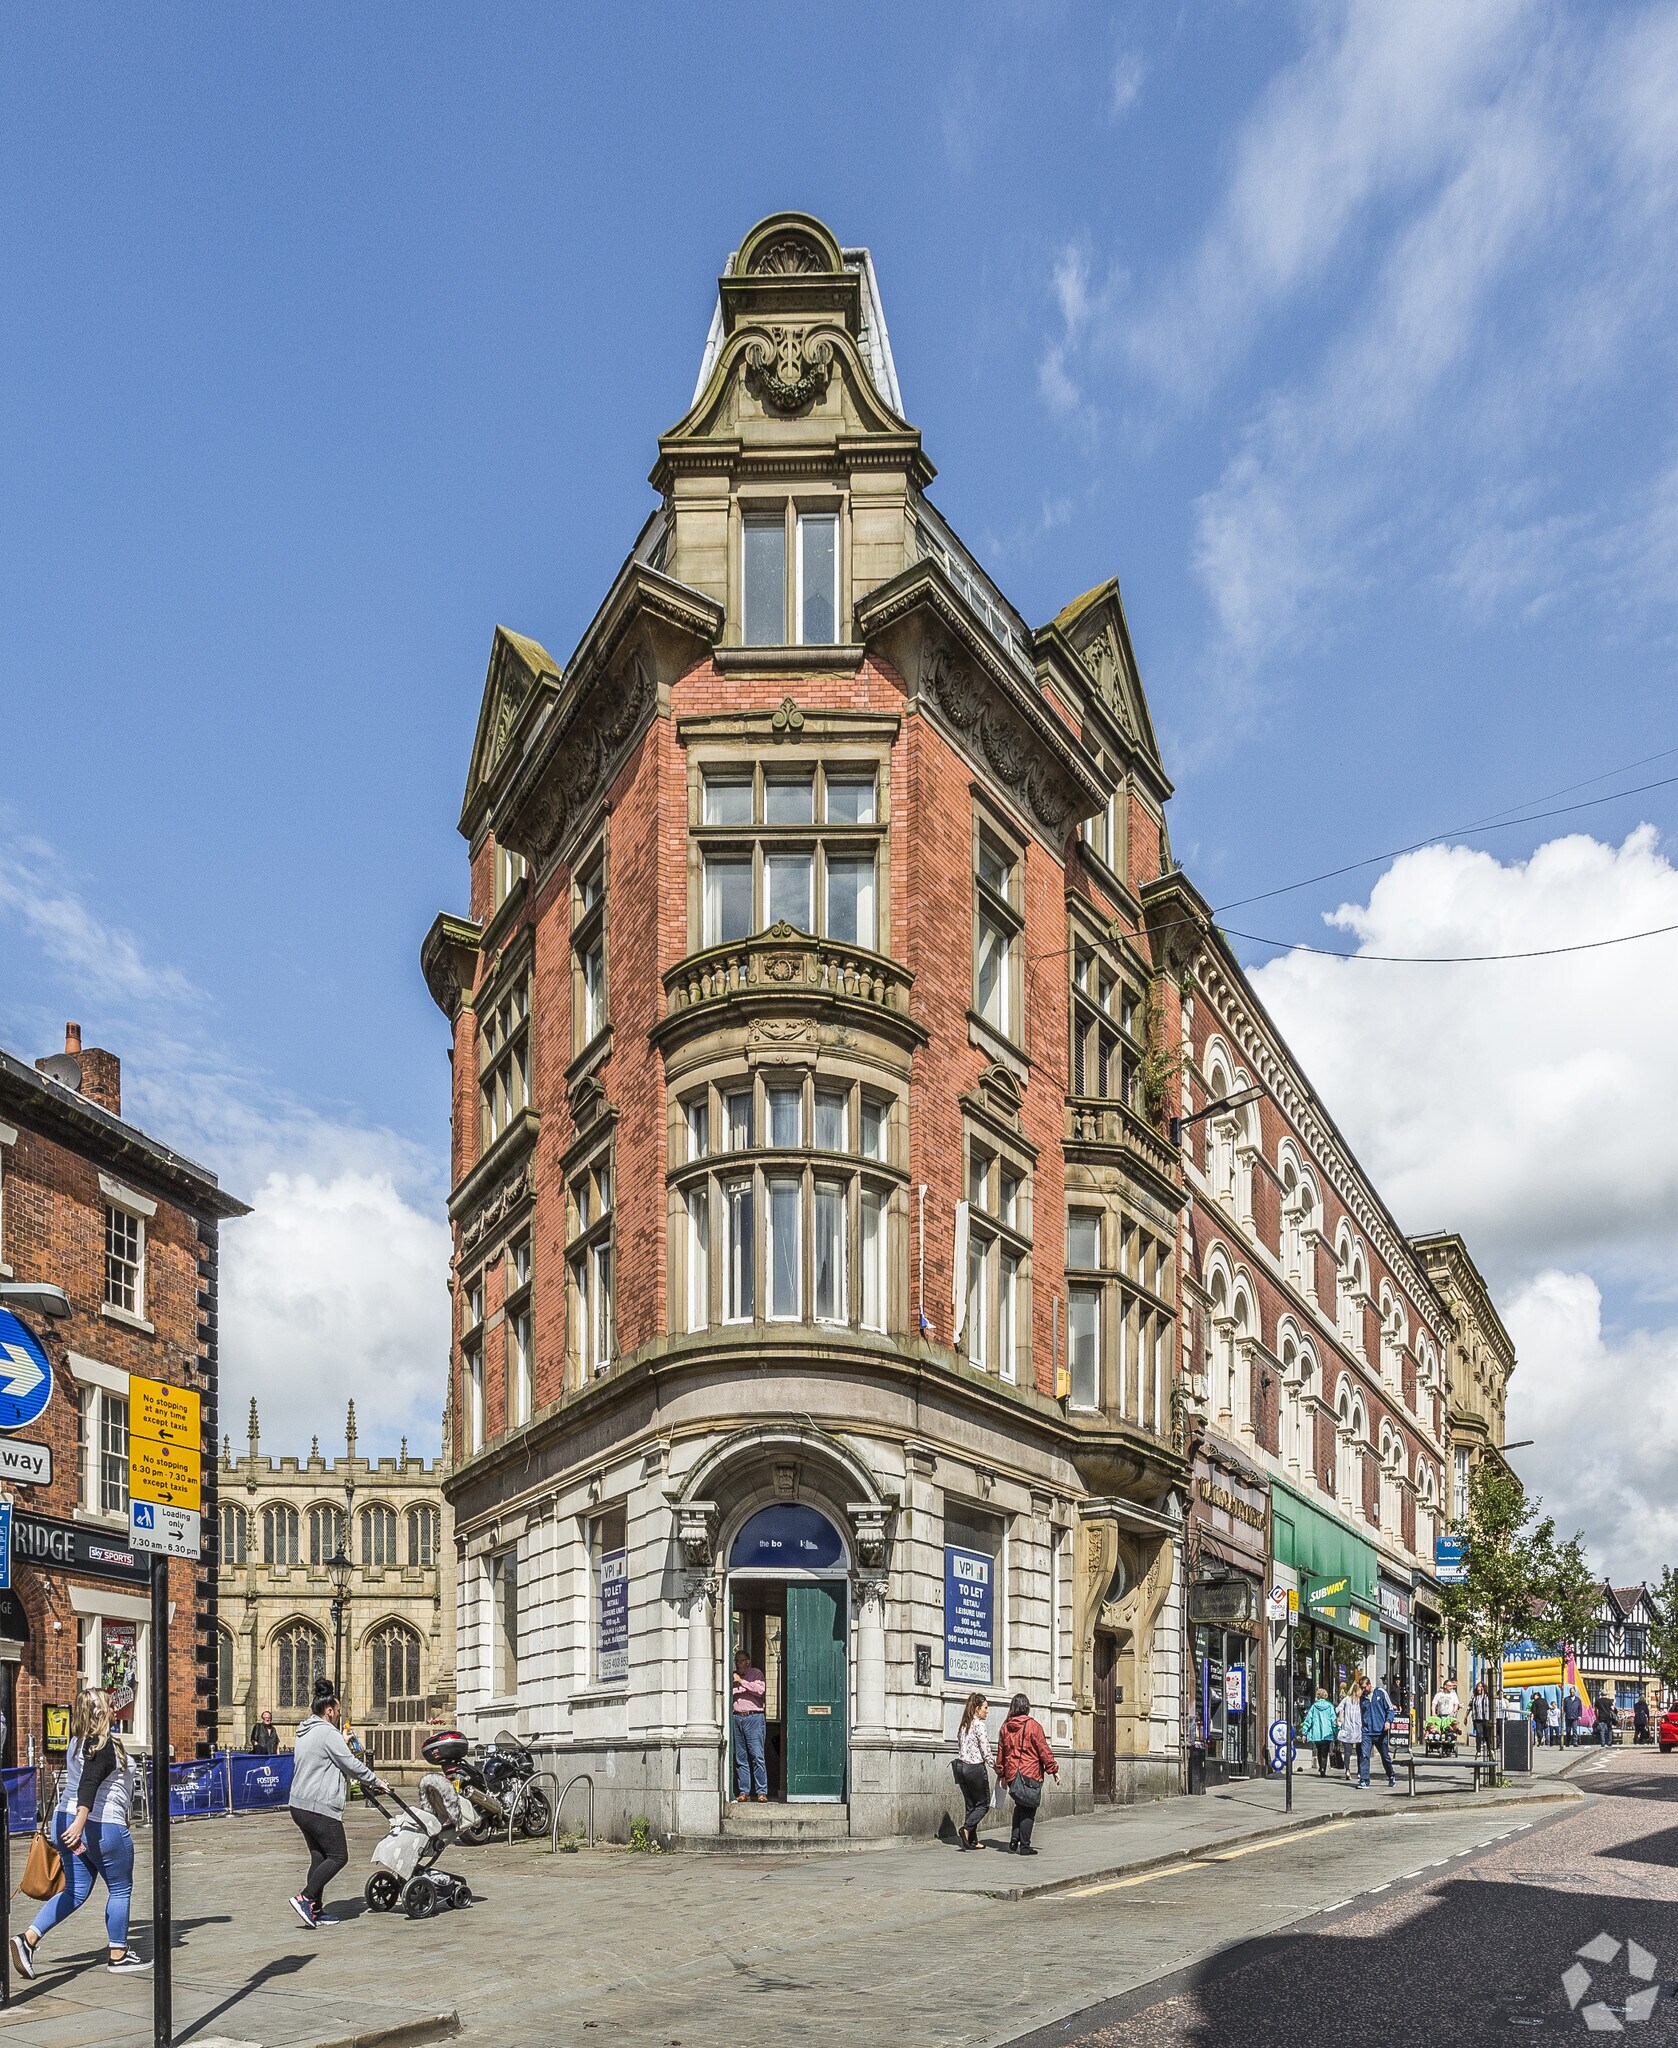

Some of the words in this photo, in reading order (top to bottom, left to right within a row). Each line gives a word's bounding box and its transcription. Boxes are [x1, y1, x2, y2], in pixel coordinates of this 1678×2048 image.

[143, 1394, 154, 1403] No
[156, 1399, 188, 1413] stopping
[155, 1407, 168, 1417] any
[171, 1411, 186, 1421] time
[143, 1415, 168, 1427] except
[170, 1421, 188, 1432] taxis
[2, 1451, 43, 1475] way
[144, 1455, 154, 1463] No
[156, 1459, 188, 1472] stopping
[132, 1464, 150, 1474] 6.30
[169, 1472, 186, 1482] 7.30
[143, 1478, 168, 1489] except
[170, 1483, 188, 1492] taxis
[162, 1508, 191, 1521] Loading
[168, 1520, 184, 1529] only
[11, 1521, 74, 1562] RIDGE
[132, 1537, 150, 1547] 7.30
[168, 1544, 185, 1553] 6.30
[91, 1549, 102, 1558] sky
[104, 1551, 132, 1563] SPORTS
[604, 1564, 614, 1578] VPI
[960, 1560, 973, 1576] VPI
[604, 1587, 611, 1598] TO
[612, 1584, 622, 1596] LET
[959, 1584, 969, 1596] TO
[970, 1586, 983, 1599] LET
[1309, 1578, 1347, 1602] SUBWAY
[955, 1606, 975, 1617] LEISURE
[976, 1611, 986, 1619] UNIT
[615, 1625, 626, 1633] FLOOR
[953, 1626, 973, 1635] GROUND
[974, 1629, 987, 1638] FLOOR
[970, 1638, 991, 1648] BASEMENT
[950, 1658, 968, 1670] 01625
[969, 1660, 979, 1672] 403
[980, 1662, 989, 1673] 853
